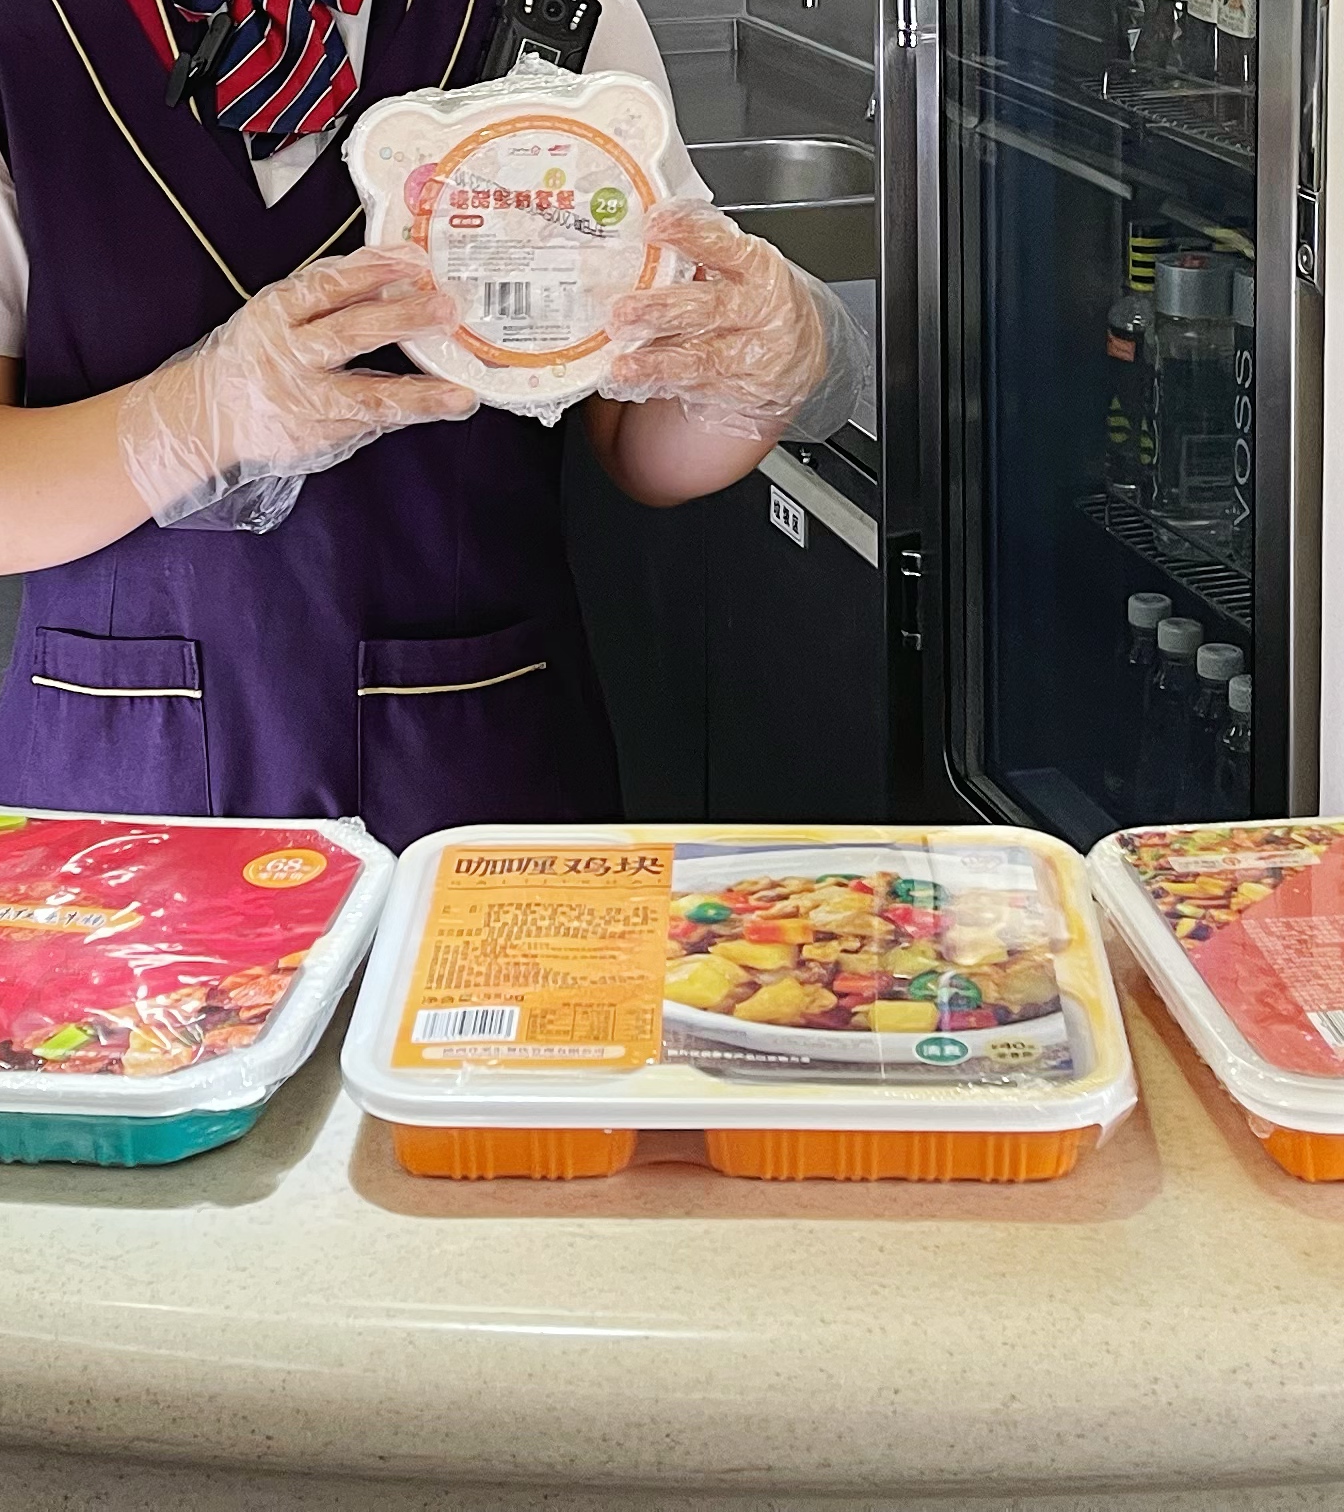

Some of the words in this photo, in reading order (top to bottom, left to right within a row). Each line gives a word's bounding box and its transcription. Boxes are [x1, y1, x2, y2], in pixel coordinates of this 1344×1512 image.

[1234, 350, 1253, 525] VOSS
[456, 856, 665, 876] 咖喱鸡块
